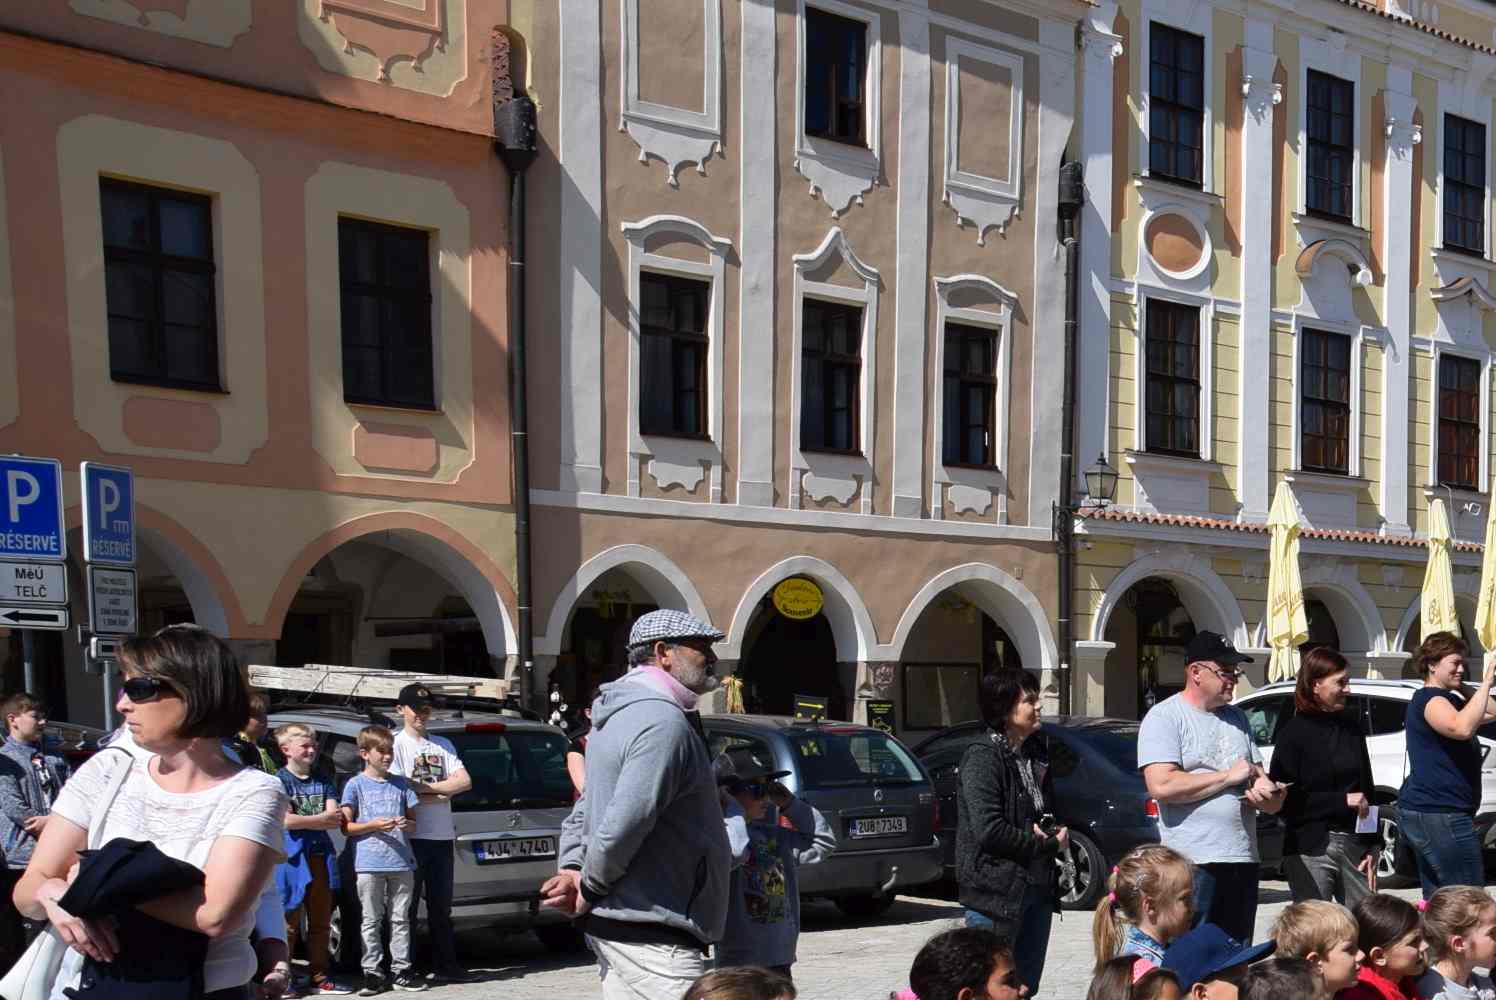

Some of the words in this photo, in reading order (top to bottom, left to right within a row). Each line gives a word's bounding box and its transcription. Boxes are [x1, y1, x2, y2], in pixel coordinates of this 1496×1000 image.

[7, 469, 41, 523] P
[98, 478, 121, 530] P
[0, 529, 59, 551] RÉSERVÉ
[92, 536, 131, 559] RÉSERVÉ
[14, 584, 48, 598] TELČ
[519, 839, 549, 855] 4740
